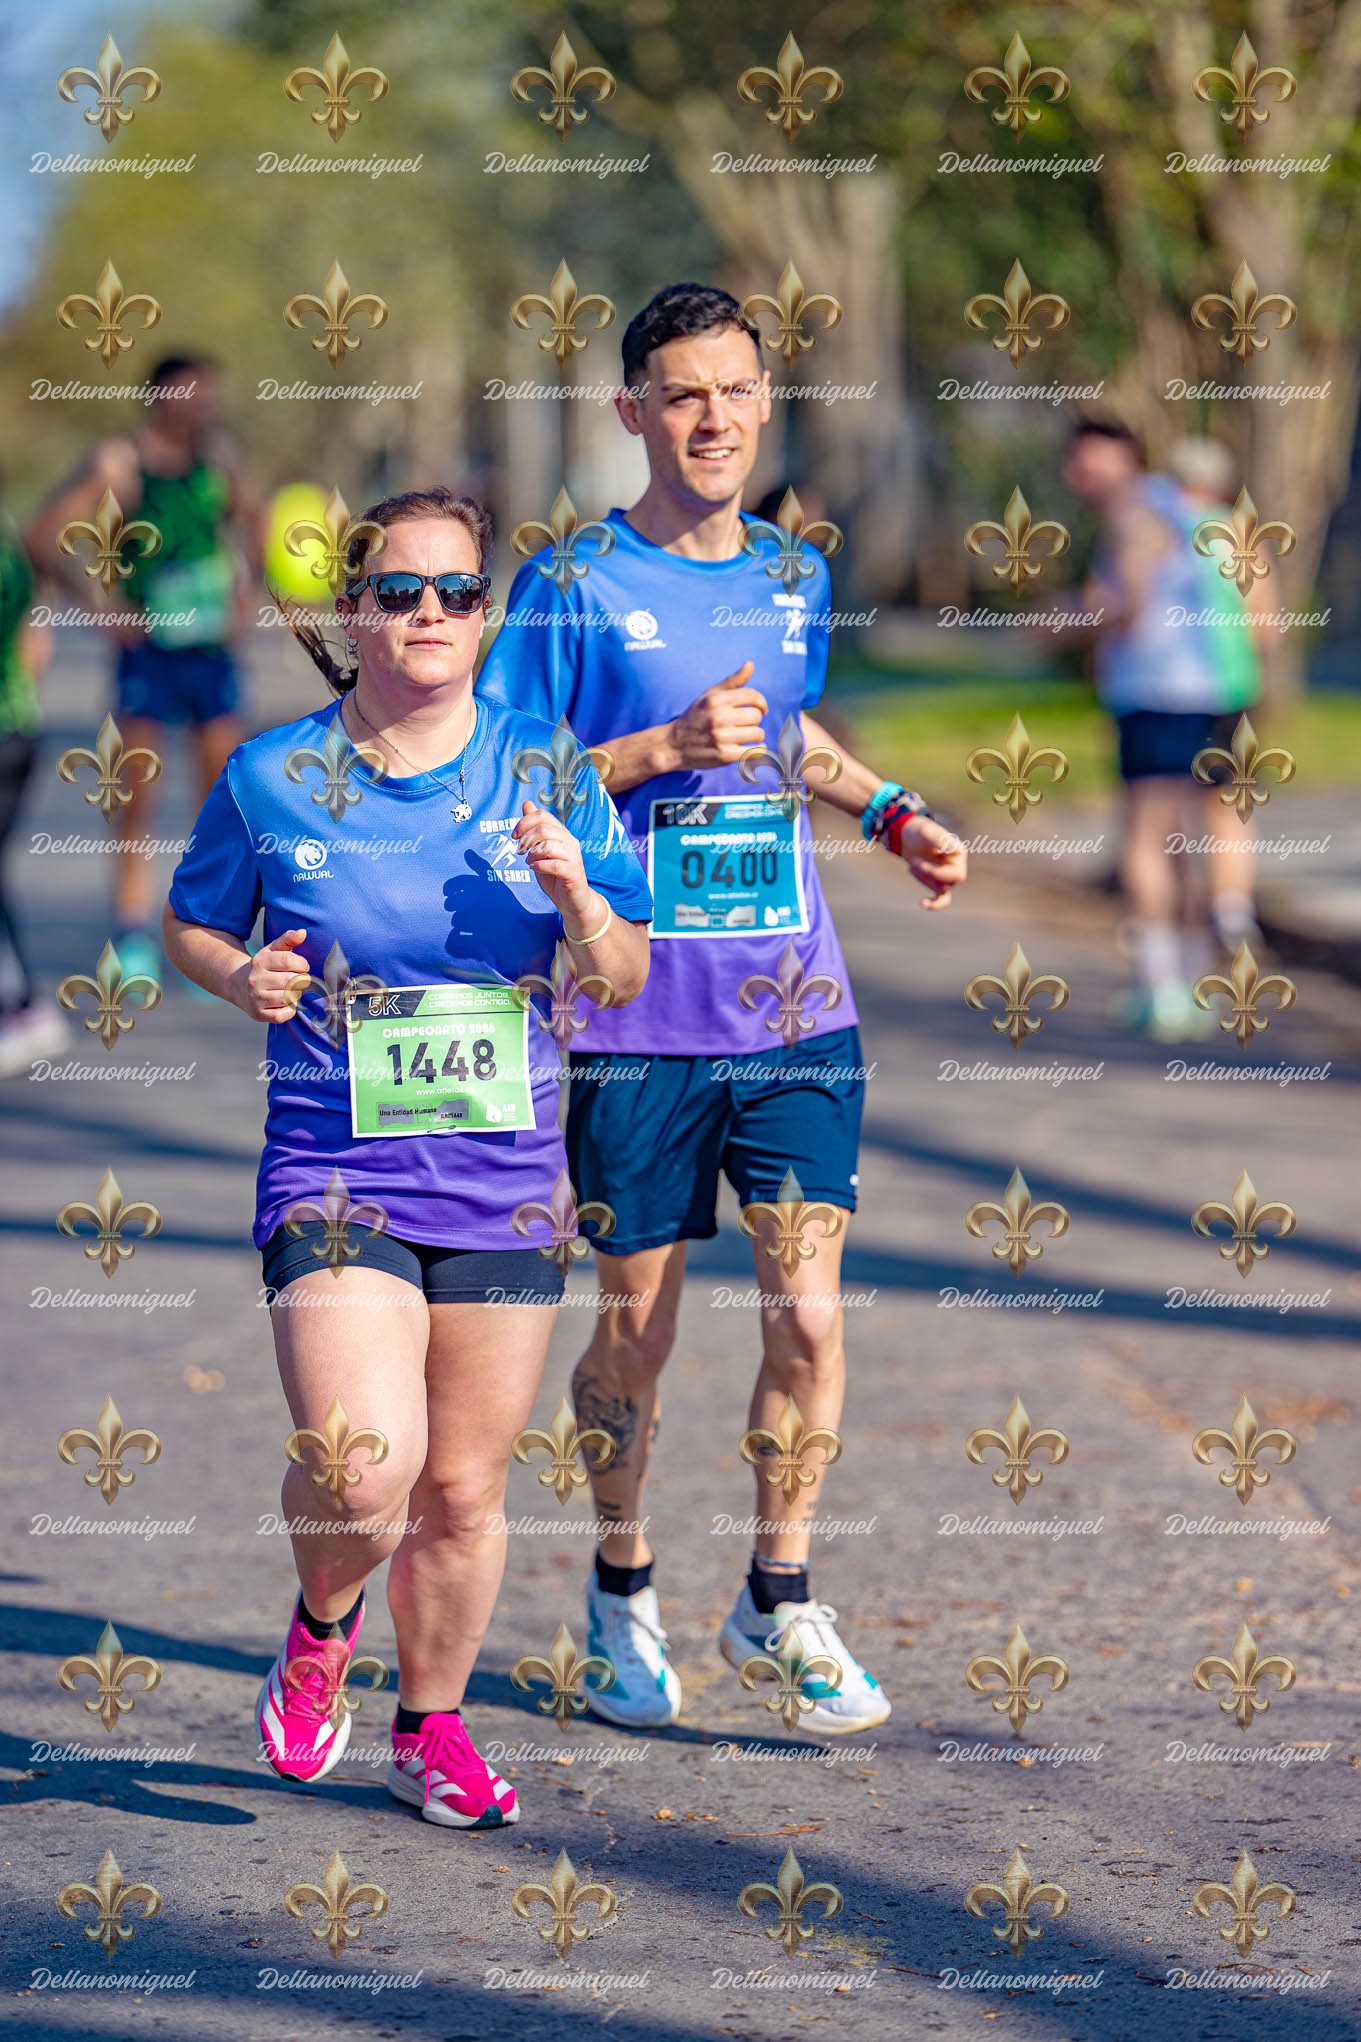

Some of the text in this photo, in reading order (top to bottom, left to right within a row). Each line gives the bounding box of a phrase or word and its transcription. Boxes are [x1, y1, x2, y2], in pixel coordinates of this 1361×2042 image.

[480, 817, 521, 833] CORREM
[663, 803, 708, 825] 10K
[504, 869, 531, 883] SABER
[681, 850, 778, 888] 0400
[368, 994, 401, 1017] 5K
[382, 1024, 467, 1039] CAMPEONATO
[386, 1039, 497, 1086] 1448
